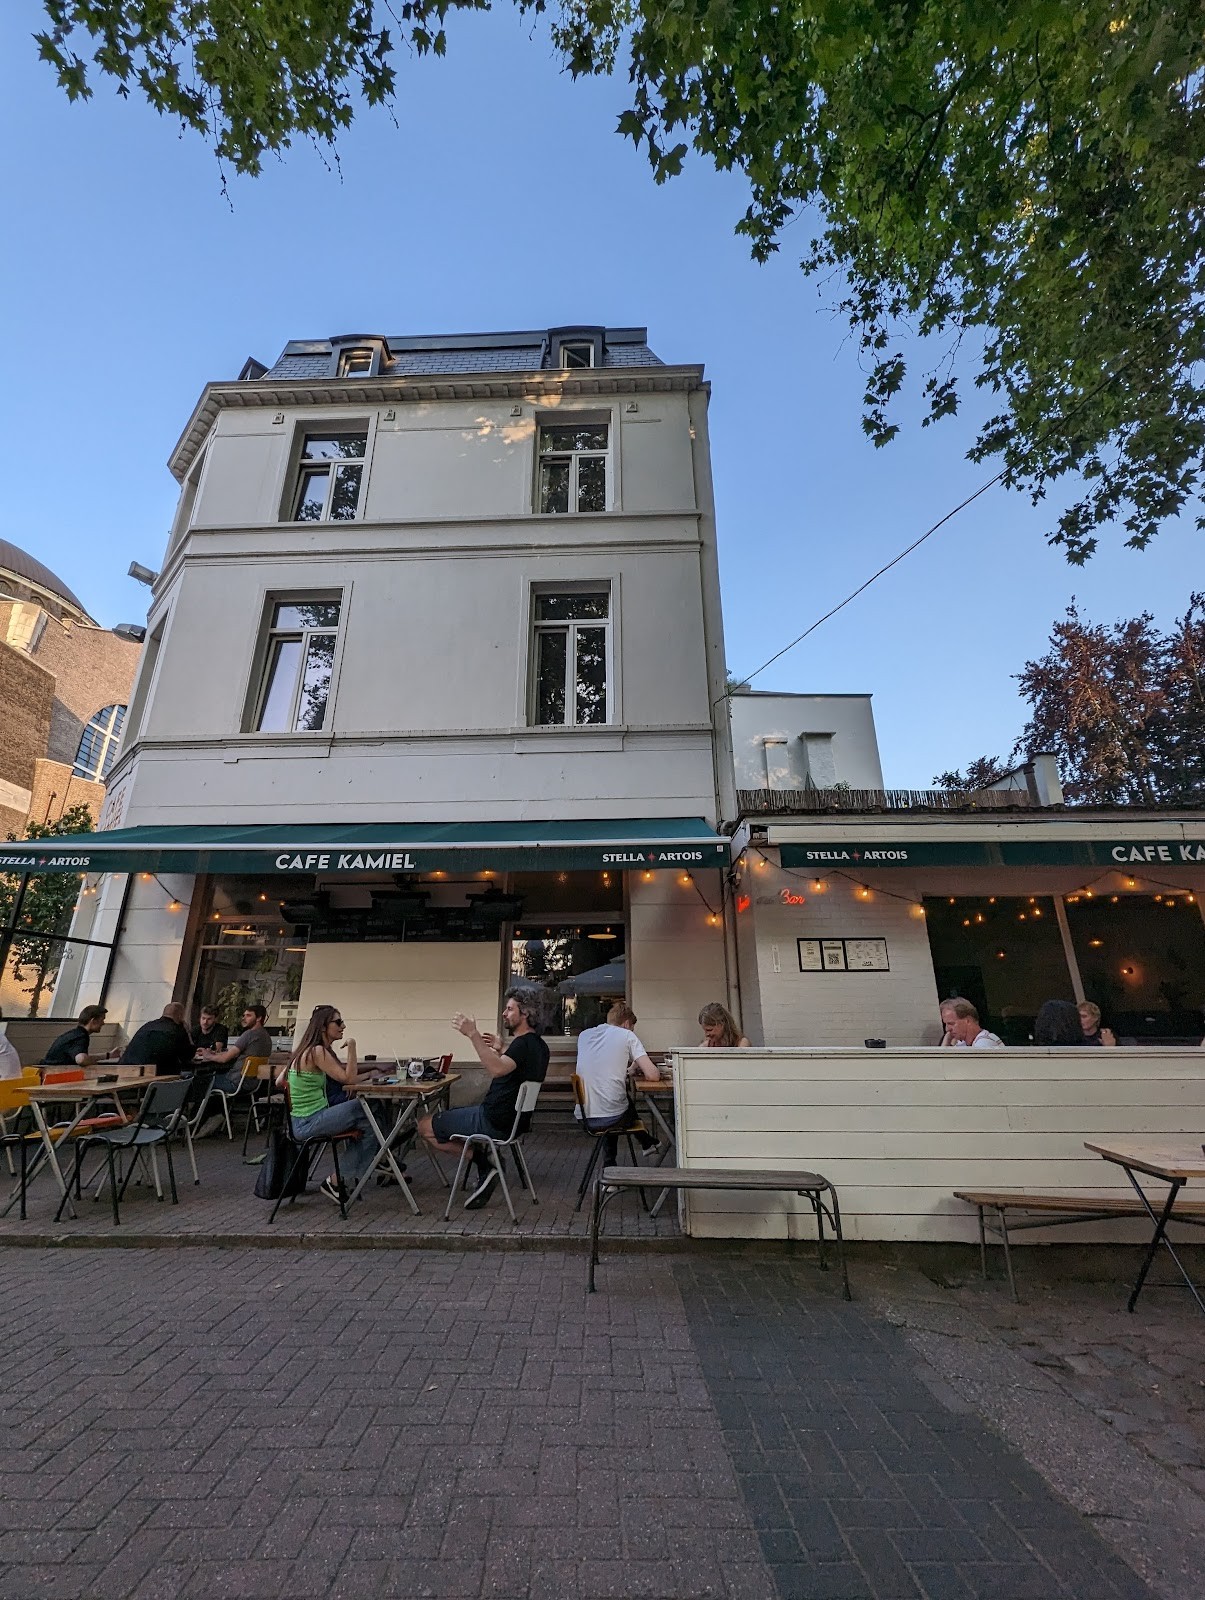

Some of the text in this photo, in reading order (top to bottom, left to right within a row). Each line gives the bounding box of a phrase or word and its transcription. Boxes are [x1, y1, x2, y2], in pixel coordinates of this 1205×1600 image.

[602, 851, 703, 862] STELLA ARTOIS
[806, 850, 908, 860] STELLA ARTOIS
[1111, 845, 1173, 862] CAFE
[47, 857, 91, 866] ARTOIS
[275, 853, 415, 869] CAFE KAMIEL
[780, 888, 806, 905] Bar
